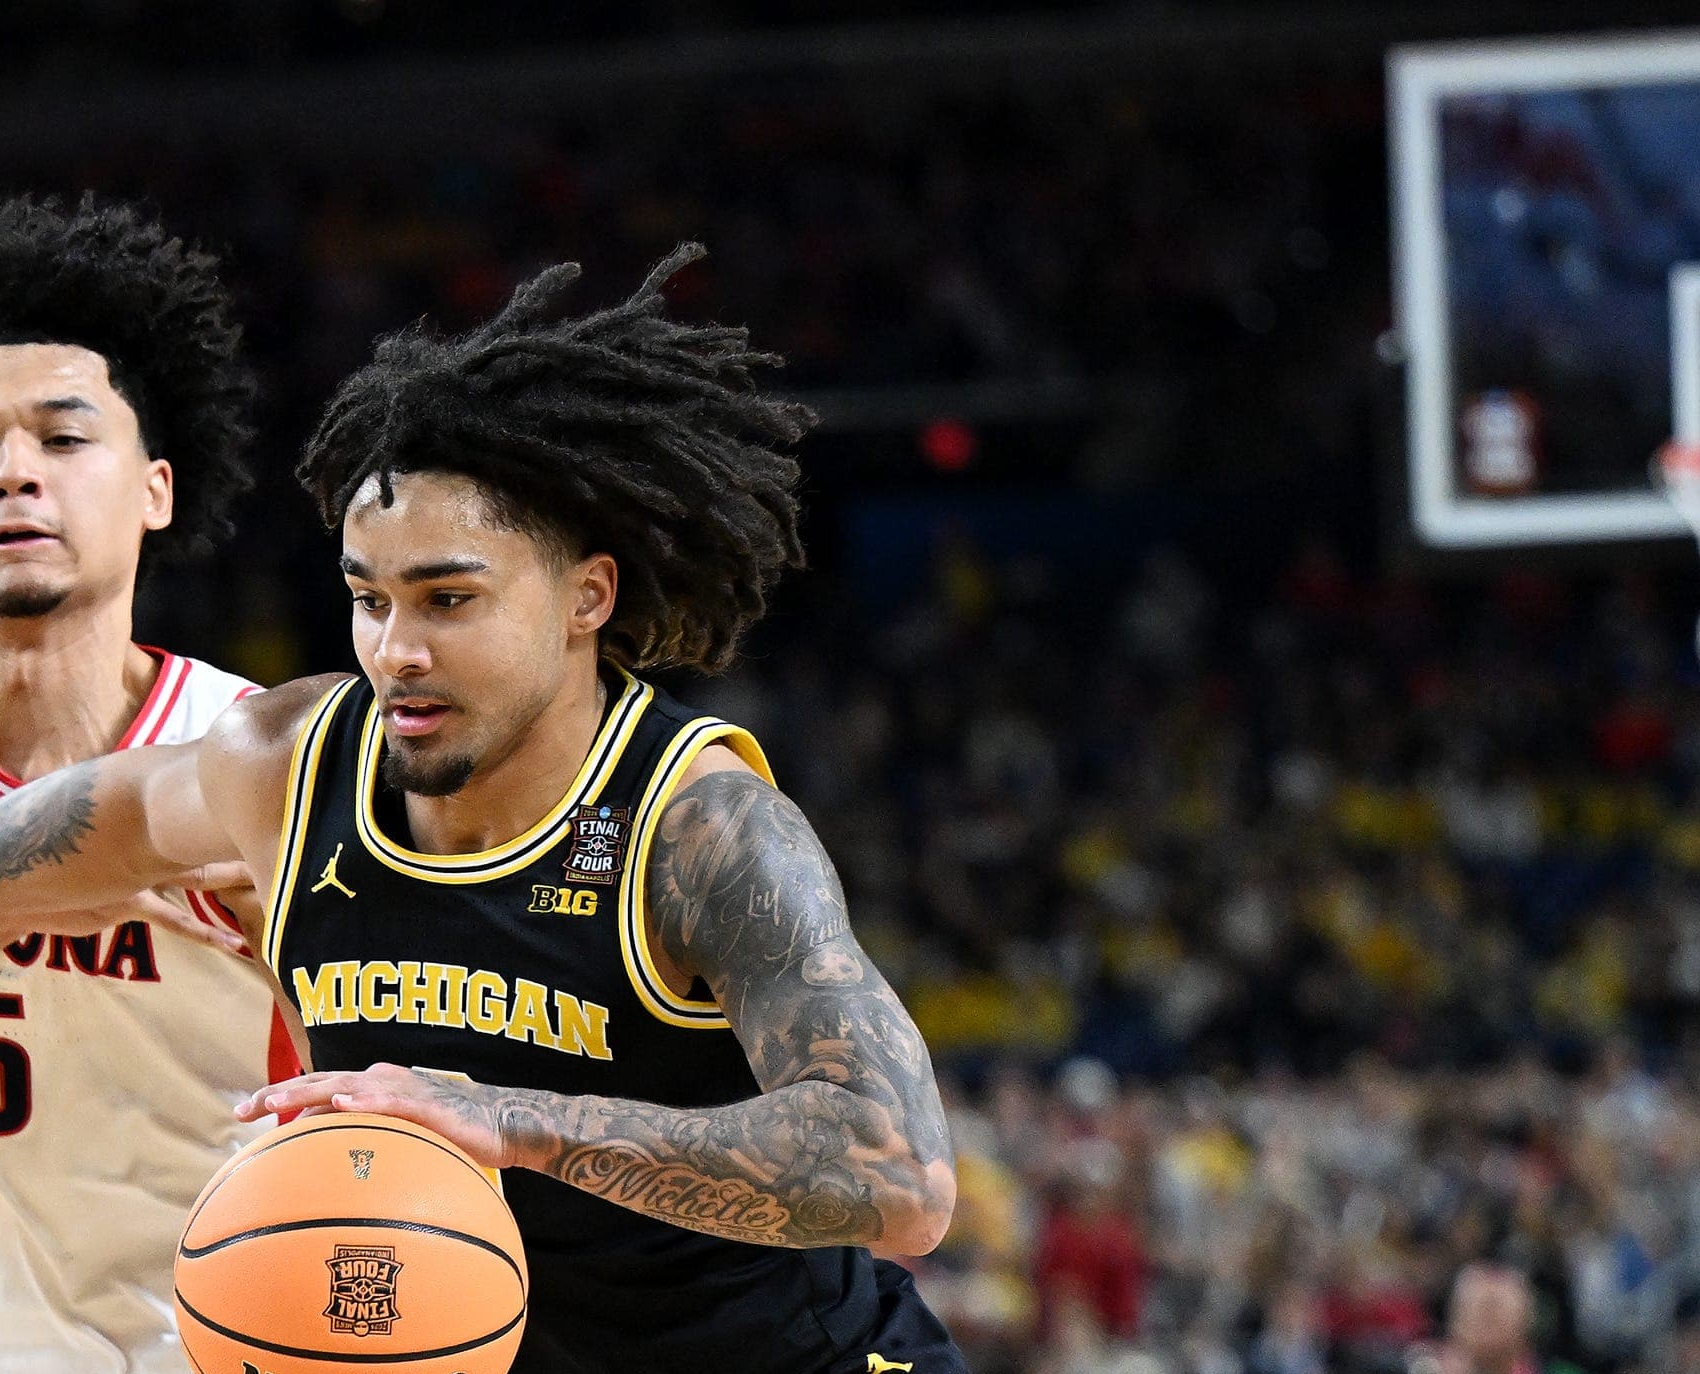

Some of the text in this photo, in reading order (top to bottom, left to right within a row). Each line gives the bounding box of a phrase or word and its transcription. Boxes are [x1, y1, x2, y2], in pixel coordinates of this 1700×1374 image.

[579, 820, 621, 838] FINAL
[571, 853, 613, 872] FOUR
[292, 960, 614, 1061] MICHIGAN
[338, 1260, 391, 1281] FOUR
[338, 1299, 390, 1319] FINAL
